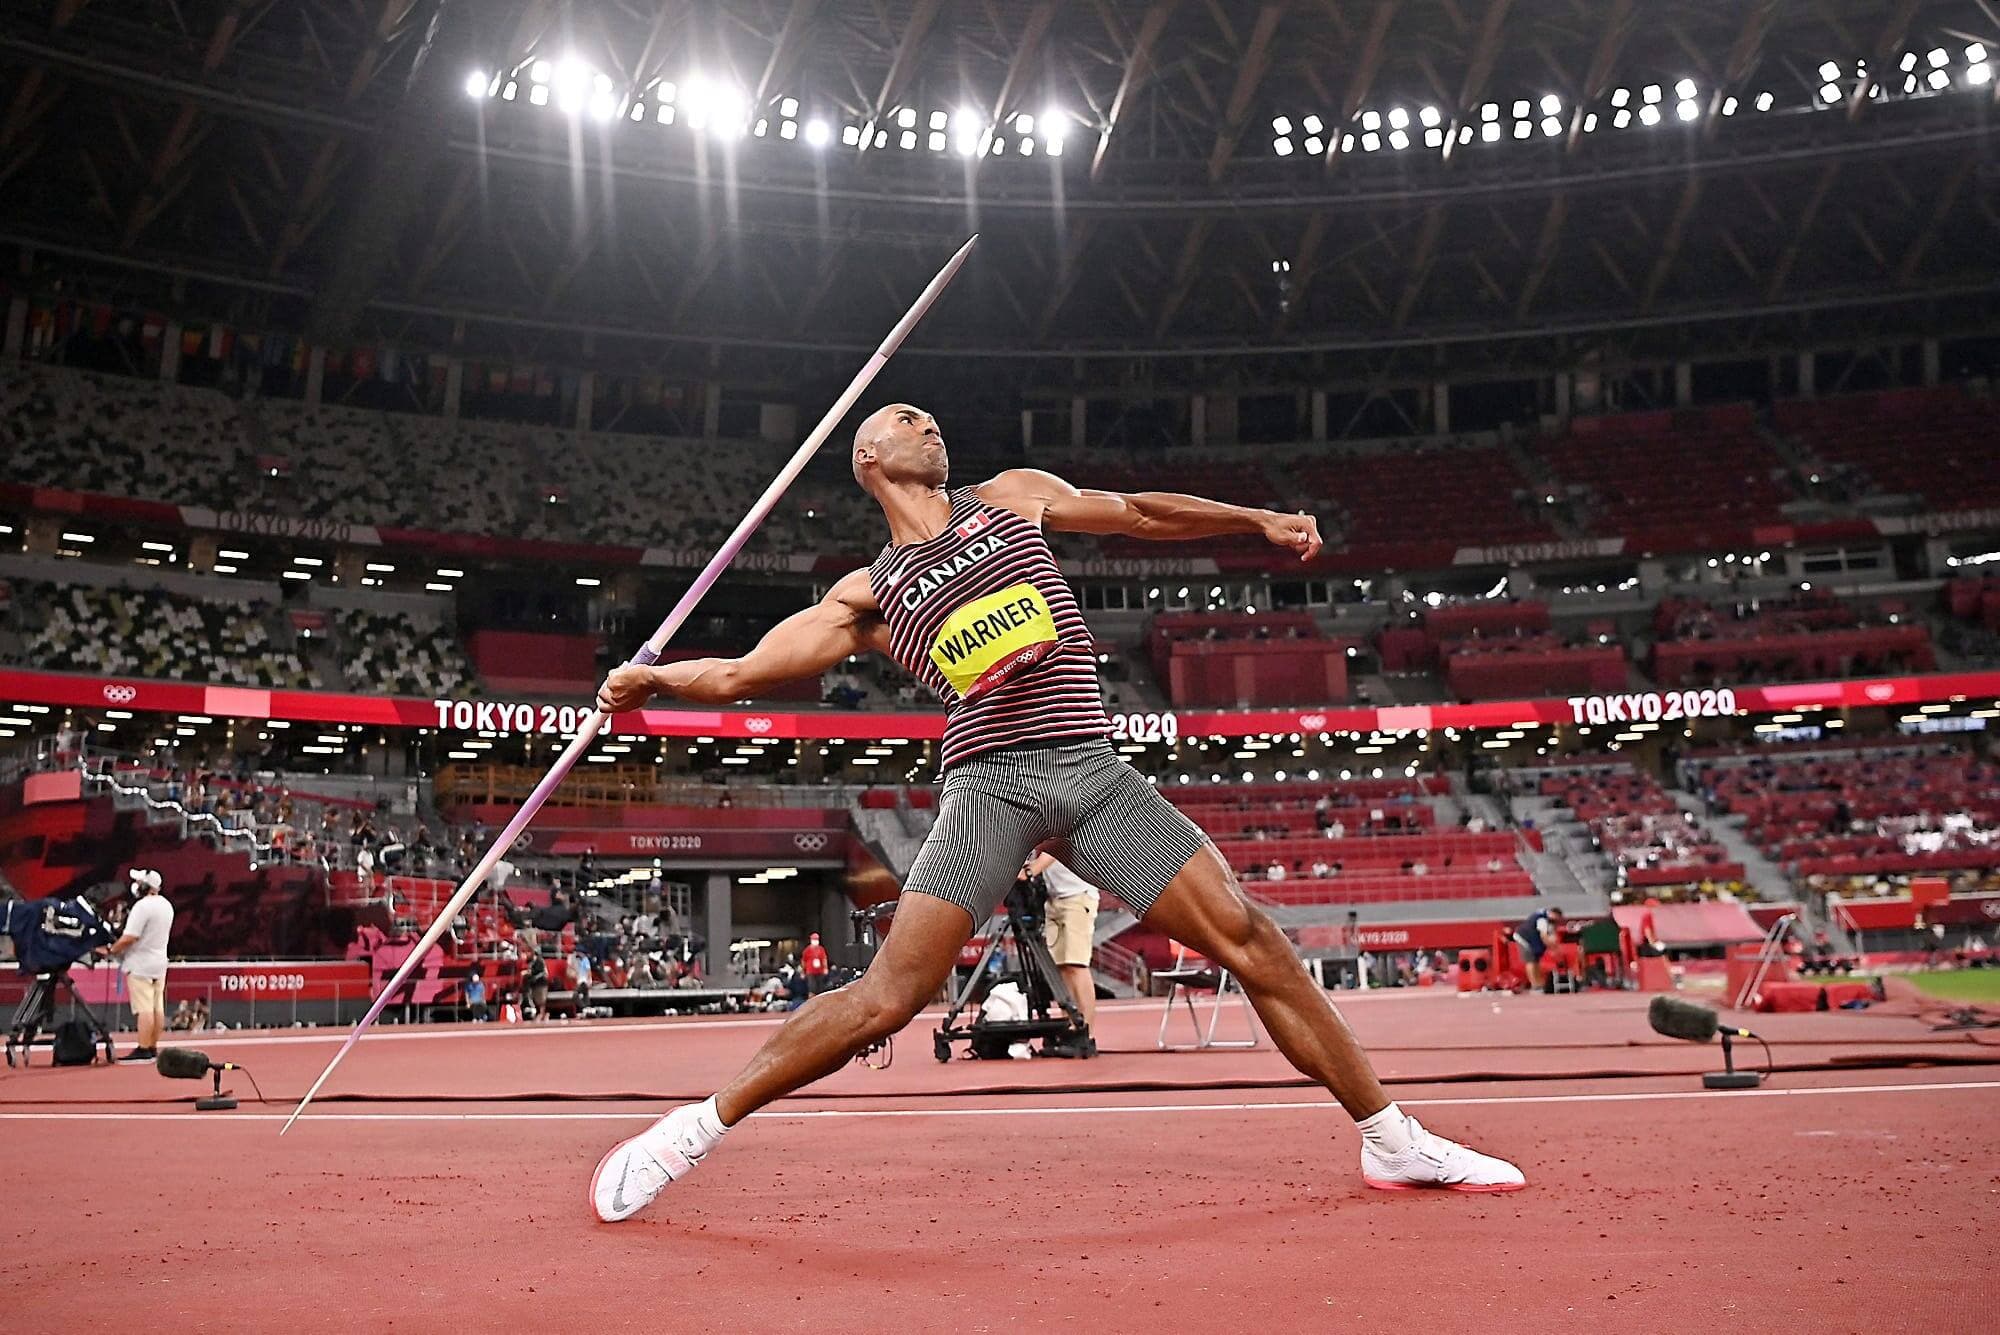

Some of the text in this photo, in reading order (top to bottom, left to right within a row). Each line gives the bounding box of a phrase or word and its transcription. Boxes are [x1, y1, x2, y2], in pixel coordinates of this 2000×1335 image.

[214, 511, 350, 540] TOKYO 2020
[901, 534, 1009, 612] CANADA
[937, 597, 1041, 666] WARNER
[434, 699, 534, 733] TOKYO
[1567, 688, 1736, 725] TOKYO 2020
[1111, 713, 1178, 741] 2020
[630, 835, 702, 849] TOKYO 2020
[219, 974, 304, 992] TOKYO 2020
